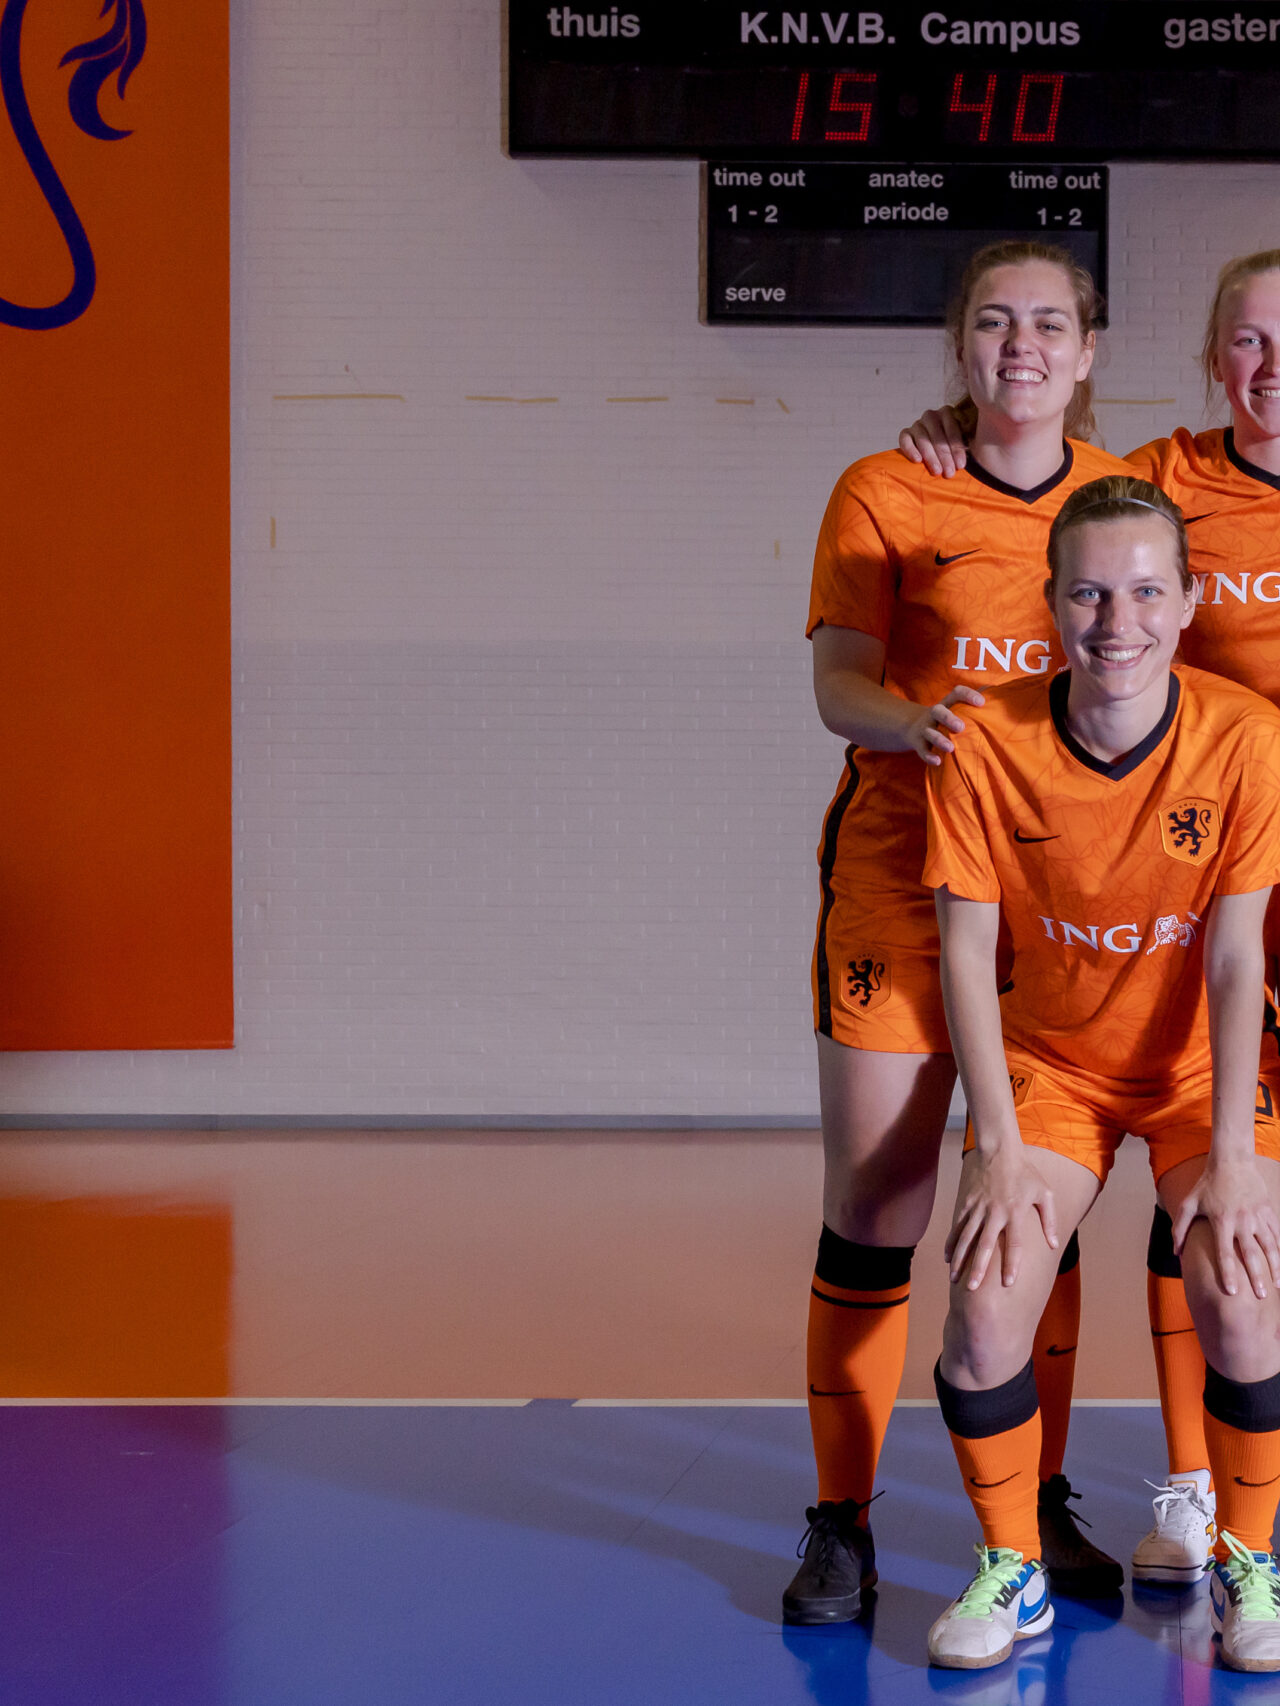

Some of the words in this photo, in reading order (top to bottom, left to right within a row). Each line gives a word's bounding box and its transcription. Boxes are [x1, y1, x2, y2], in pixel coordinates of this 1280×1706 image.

[547, 6, 641, 38] thuis
[740, 11, 896, 44] K.N.V.B.
[920, 12, 1081, 53] Campus
[791, 73, 877, 141] 15
[949, 74, 1064, 142] 40
[713, 167, 763, 186] time
[769, 169, 806, 187] out
[868, 170, 944, 188] anatec
[1009, 170, 1058, 189] time
[1064, 172, 1101, 189] out
[864, 202, 949, 224] periode
[725, 286, 786, 302] serve
[951, 636, 1052, 674] ING
[1038, 915, 1142, 953] ING
